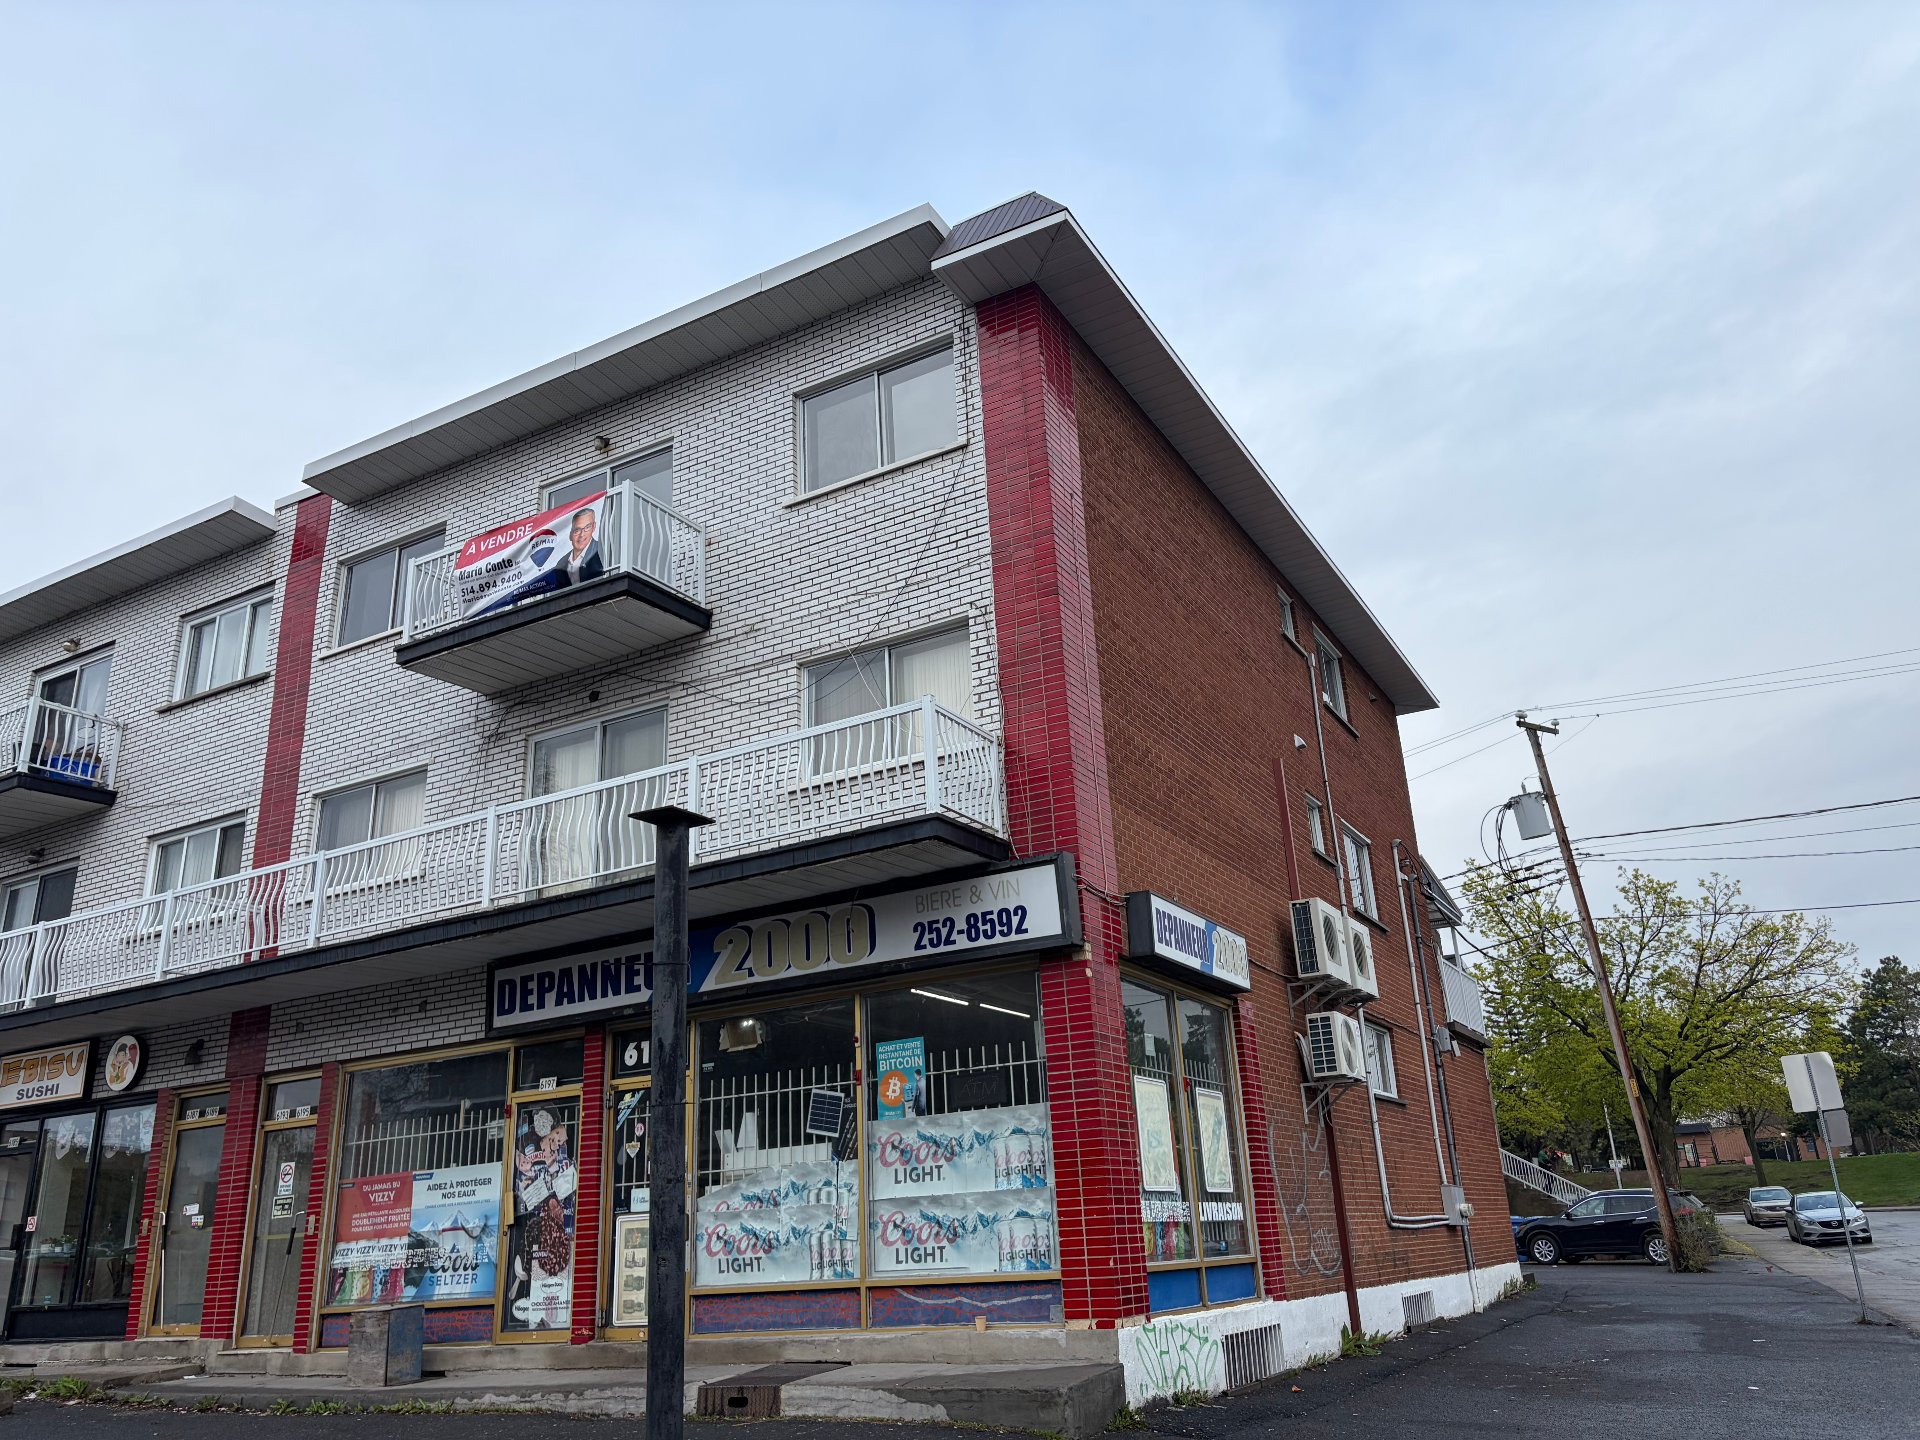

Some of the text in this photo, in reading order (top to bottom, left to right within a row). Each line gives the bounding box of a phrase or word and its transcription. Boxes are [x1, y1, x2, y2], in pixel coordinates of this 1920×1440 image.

[466, 523, 534, 556] À VENDRE
[531, 538, 555, 550] RE/MAX
[459, 566, 483, 581] Mario
[485, 558, 513, 573] Conte
[461, 571, 523, 598] 514.894.9400
[915, 877, 1020, 914] BIERE & VIN
[913, 905, 1029, 951] 252-8592
[1155, 907, 1210, 964] DEPANNEUR
[497, 903, 876, 1017] DEPANNE 2000
[878, 1044, 896, 1053] ACHAT
[904, 1041, 921, 1049] VENTE
[879, 1056, 923, 1072] BITCOIN
[16, 1083, 60, 1100] SUSHI
[540, 1079, 555, 1090] 6197
[961, 1080, 998, 1097] ATM
[878, 1132, 956, 1168] Coors
[894, 1164, 943, 1184] LIGHT
[427, 1177, 492, 1192] AIDEZ À PROTÉGER
[369, 1191, 395, 1203] VIZZY
[442, 1189, 476, 1200] NOS EAUX
[1199, 1201, 1244, 1221] LIVRAISON
[879, 1211, 959, 1247] Coors
[378, 1244, 398, 1253] VIZZY
[705, 1223, 772, 1257] Coors
[335, 1248, 355, 1257] VIZZY
[356, 1246, 377, 1255] VIZZY
[895, 1246, 946, 1264] LIGHT
[718, 1257, 762, 1273] LIGHT
[428, 1273, 478, 1286] SELTZER
